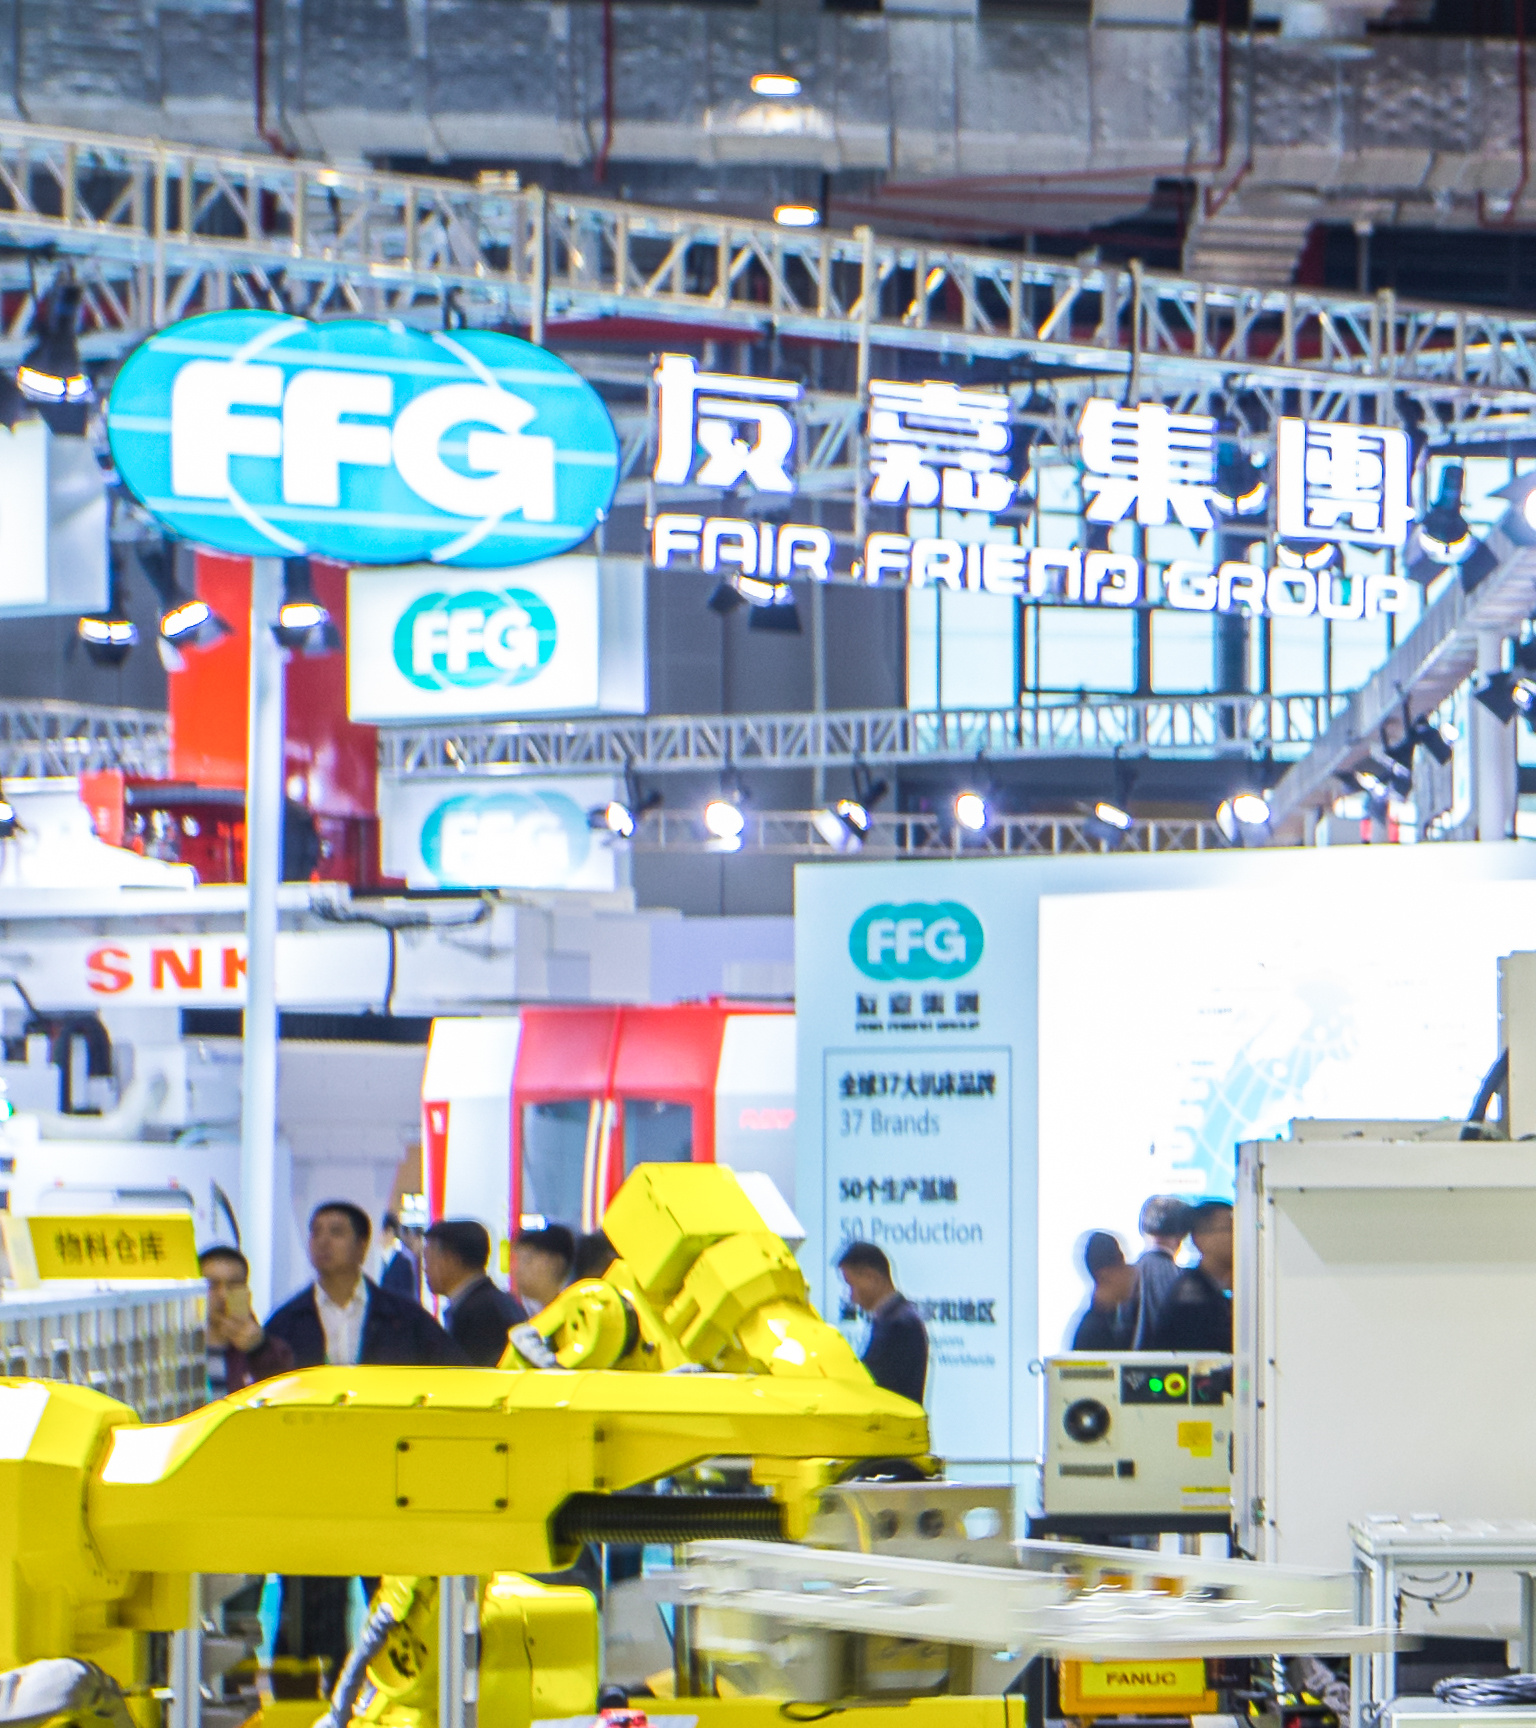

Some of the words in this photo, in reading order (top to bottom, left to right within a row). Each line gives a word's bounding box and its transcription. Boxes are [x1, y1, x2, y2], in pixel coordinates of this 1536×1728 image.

[172, 360, 555, 521] FFG
[652, 514, 834, 582] FAIR
[864, 533, 1142, 606] FRIEND
[1166, 558, 1411, 621] GROUP
[412, 608, 540, 677] FFG
[866, 917, 967, 965] FFG
[871, 1107, 941, 1138] Brands
[55, 1229, 167, 1265] 物料仓库
[871, 1215, 983, 1245] Production
[1106, 1670, 1177, 1687] FANUC
